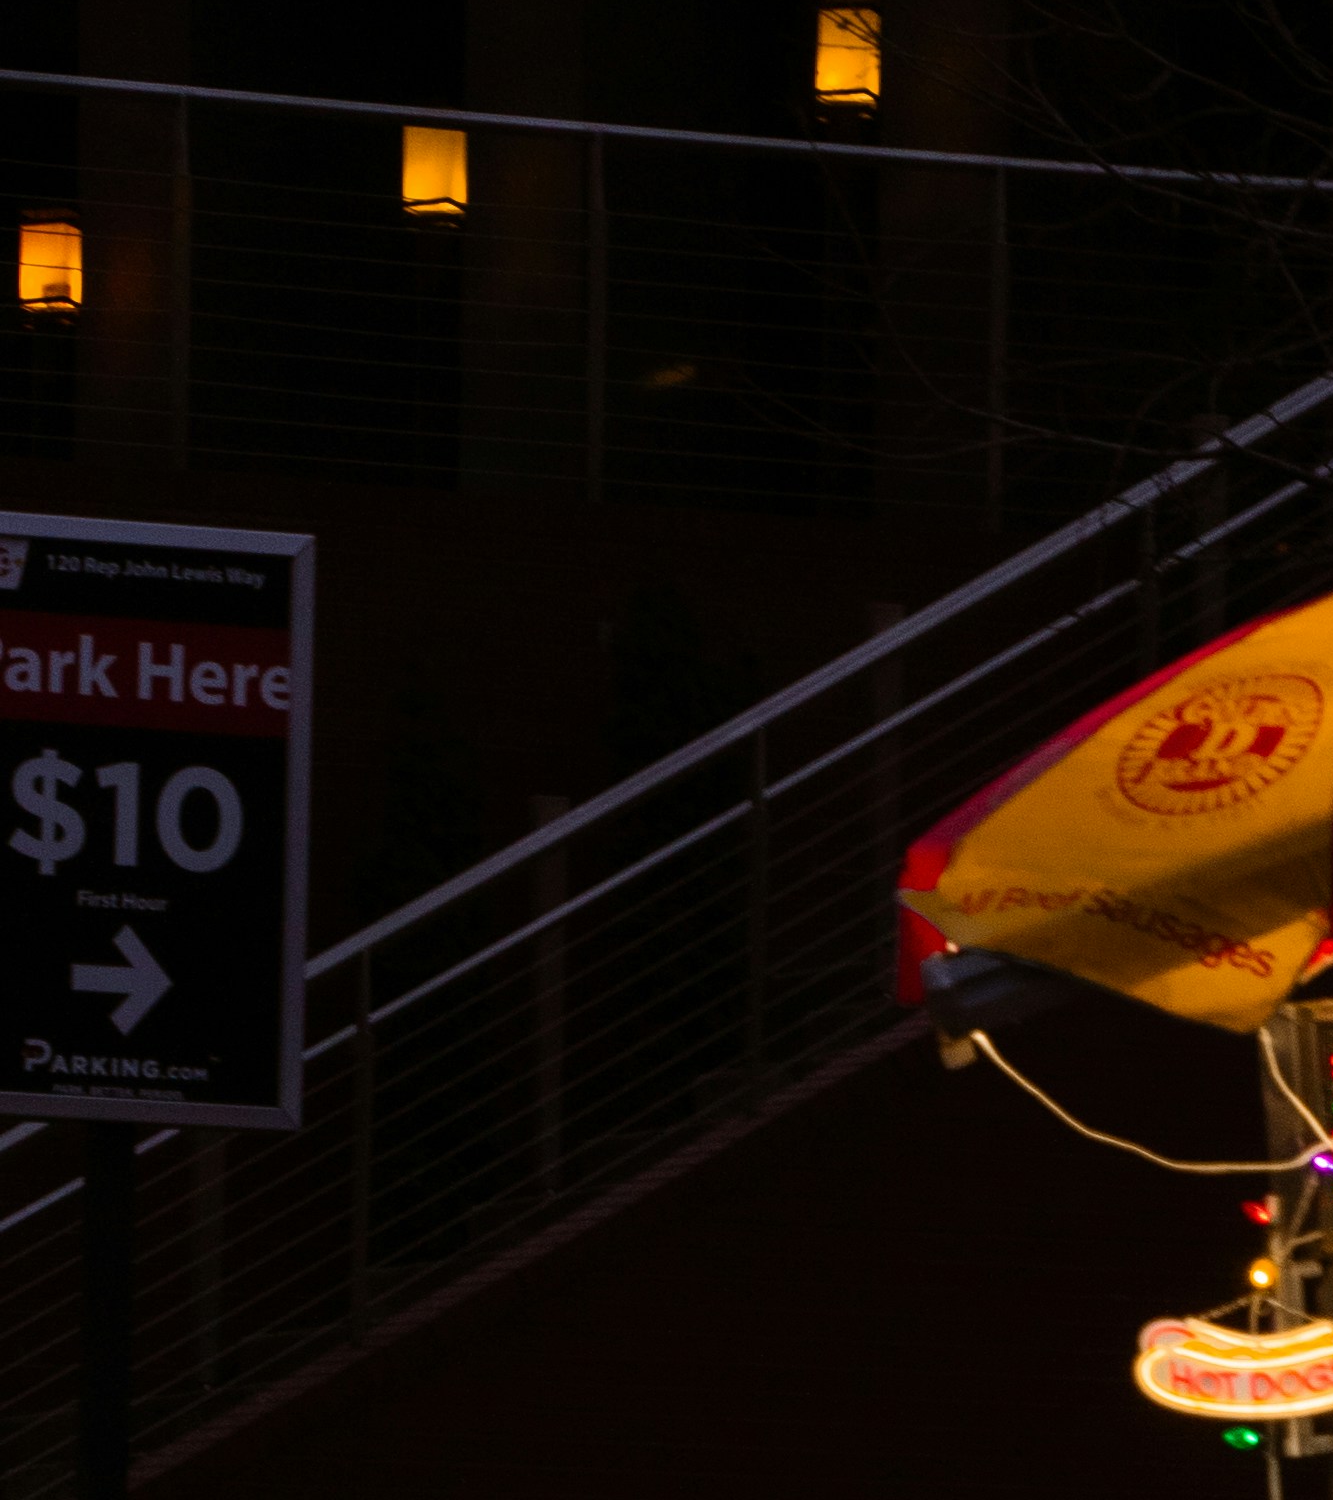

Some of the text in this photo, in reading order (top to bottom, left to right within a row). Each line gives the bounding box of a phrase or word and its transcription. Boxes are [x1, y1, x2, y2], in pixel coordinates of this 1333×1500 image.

[46, 553, 81, 573] 120
[123, 559, 169, 579] John
[170, 562, 224, 583] Lewis
[224, 566, 267, 591] Way
[0, 633, 292, 713] ark Here
[8, 746, 246, 877] $10
[1083, 889, 1276, 978] Sausages
[1168, 1358, 1238, 1400] HOT
